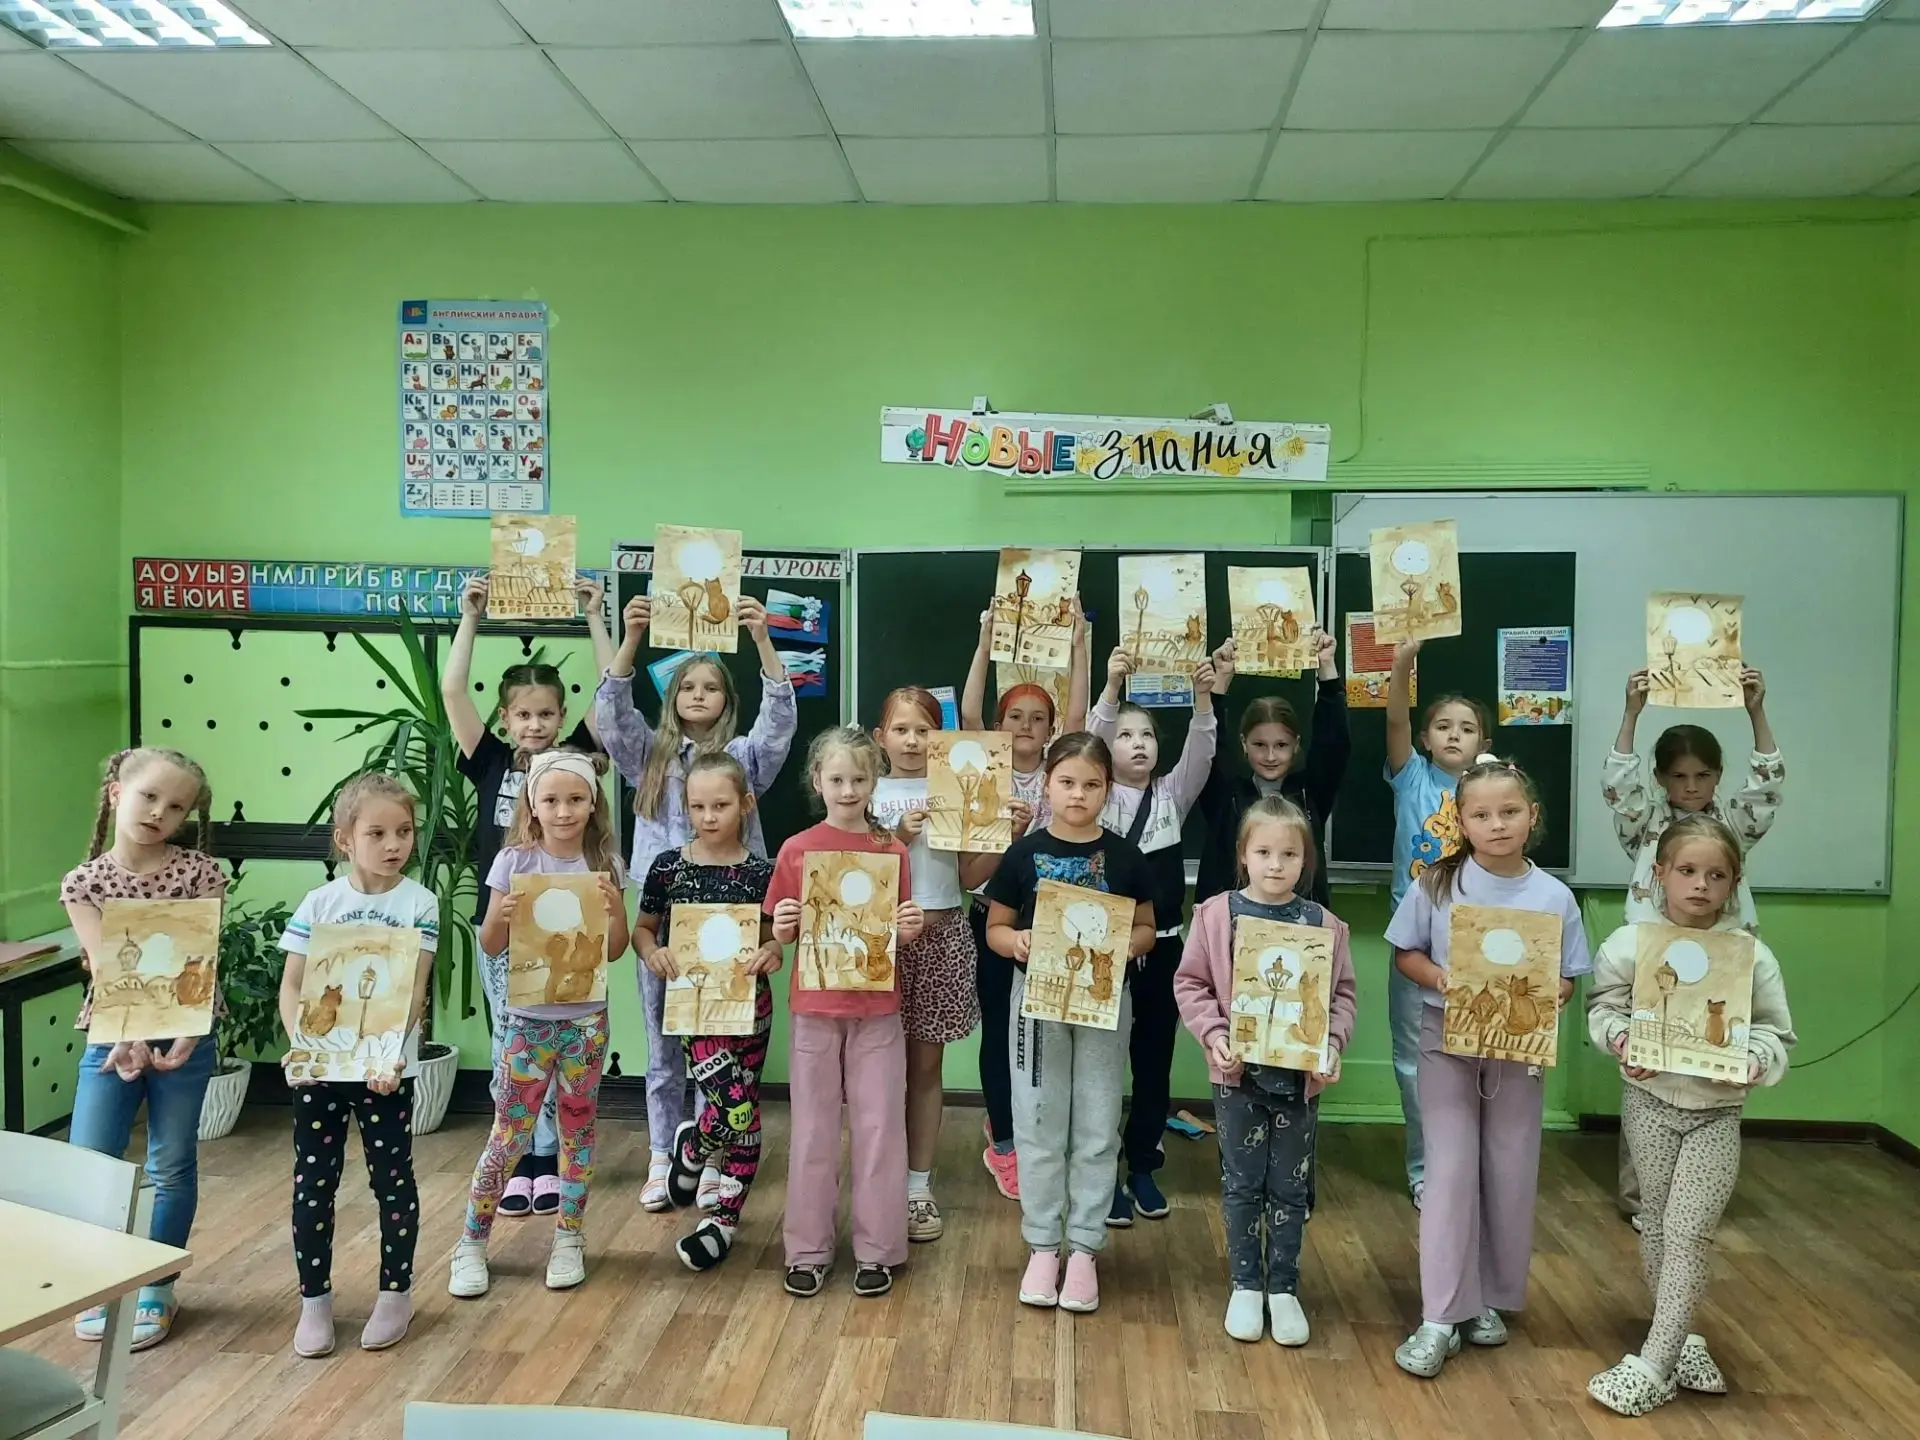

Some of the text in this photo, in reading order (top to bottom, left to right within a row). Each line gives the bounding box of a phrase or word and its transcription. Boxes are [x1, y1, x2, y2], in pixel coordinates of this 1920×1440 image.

[499, 310, 543, 319] АЛФАВИТ
[922, 413, 1075, 475] НОВЫЕ
[773, 559, 843, 578] УРОКЕ
[694, 1052, 730, 1078] BOOM!
